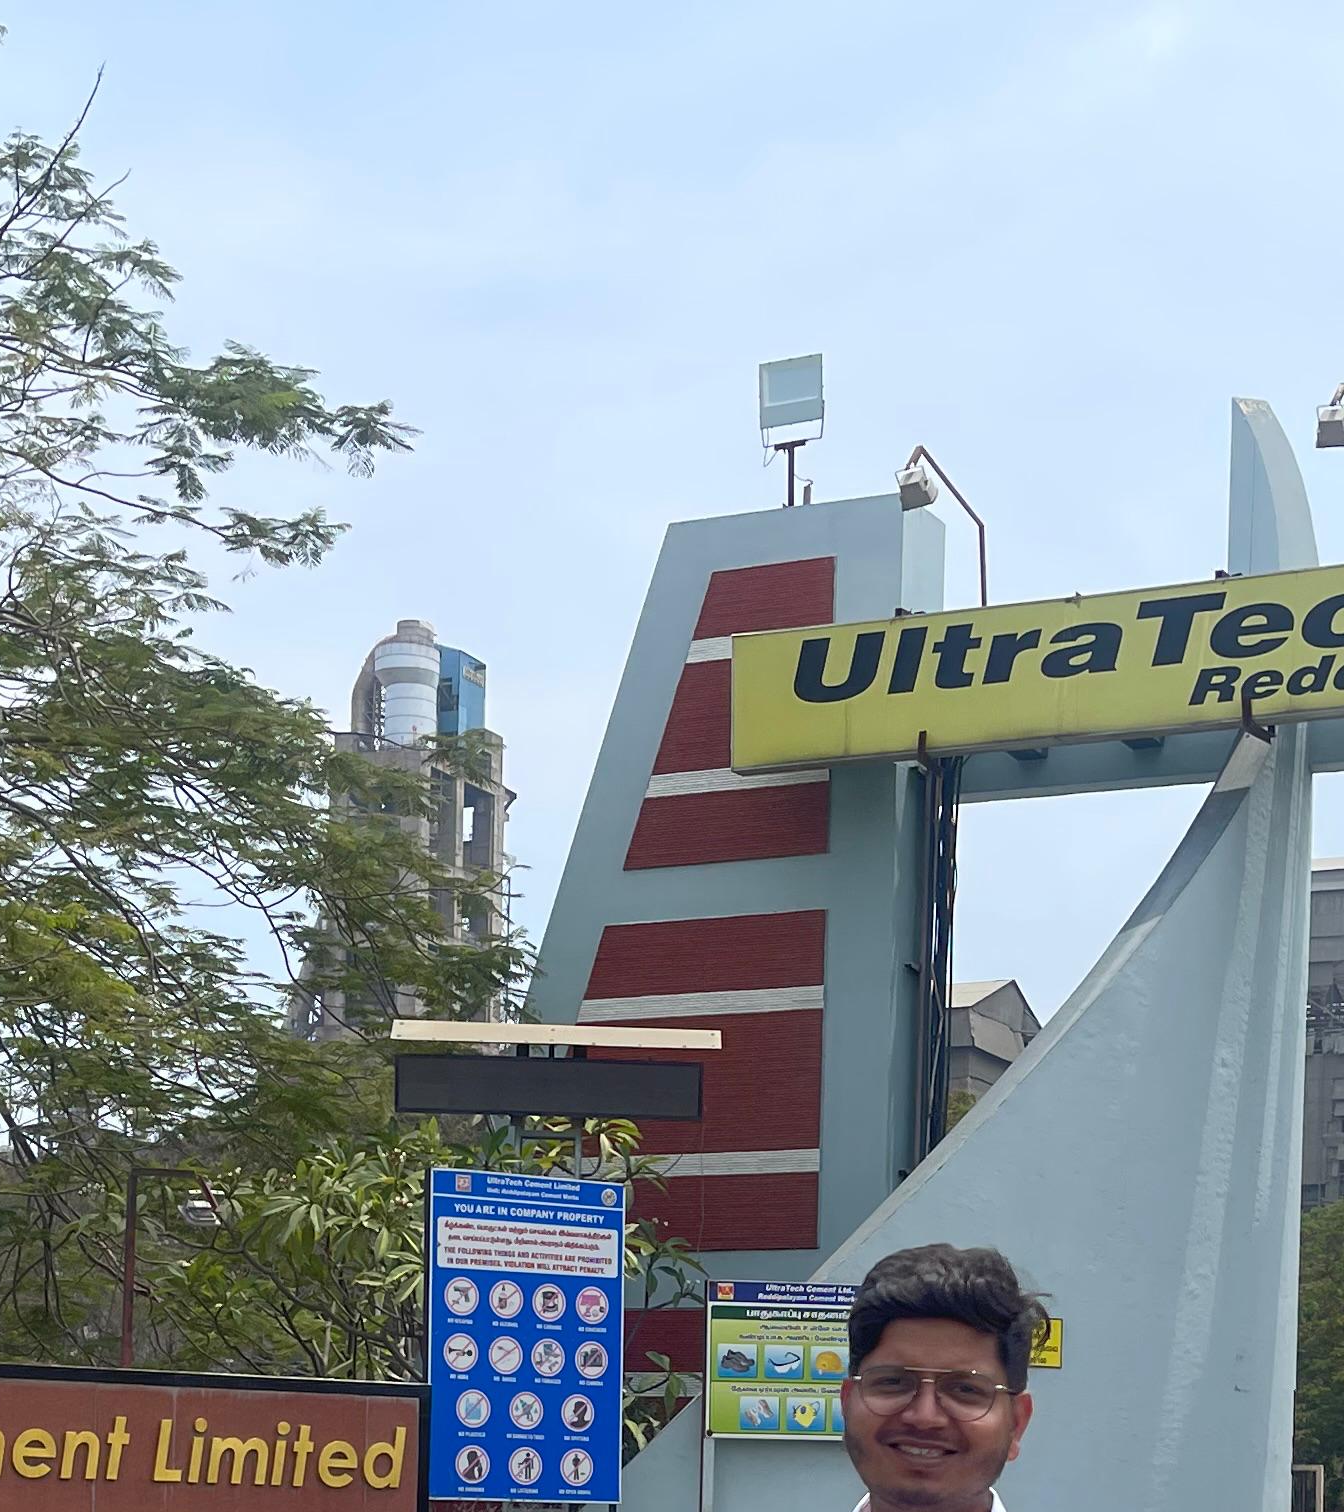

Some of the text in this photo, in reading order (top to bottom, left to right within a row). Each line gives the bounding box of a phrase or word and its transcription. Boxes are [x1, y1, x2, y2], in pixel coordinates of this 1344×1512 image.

[487, 1176, 580, 1192] UltraTech Cement Limited
[454, 1203, 605, 1224] YOU ARE IN COMPANY PROPERTY
[457, 1247, 492, 1256] FOLLOWING
[517, 1251, 529, 1259] AND
[531, 1252, 563, 1261] ACTIVITIES
[564, 1254, 576, 1262] ARE
[577, 1256, 612, 1265] PROHIBITED
[504, 1260, 535, 1269] VIOLATION
[536, 1263, 550, 1271] WILL
[552, 1264, 578, 1273] ATTRACT
[765, 1284, 804, 1293] UltraTech
[806, 1285, 836, 1293] Cement
[808, 1294, 836, 1302] Cement
[838, 1295, 856, 1303] Work
[152, 1416, 407, 1490] Limited
